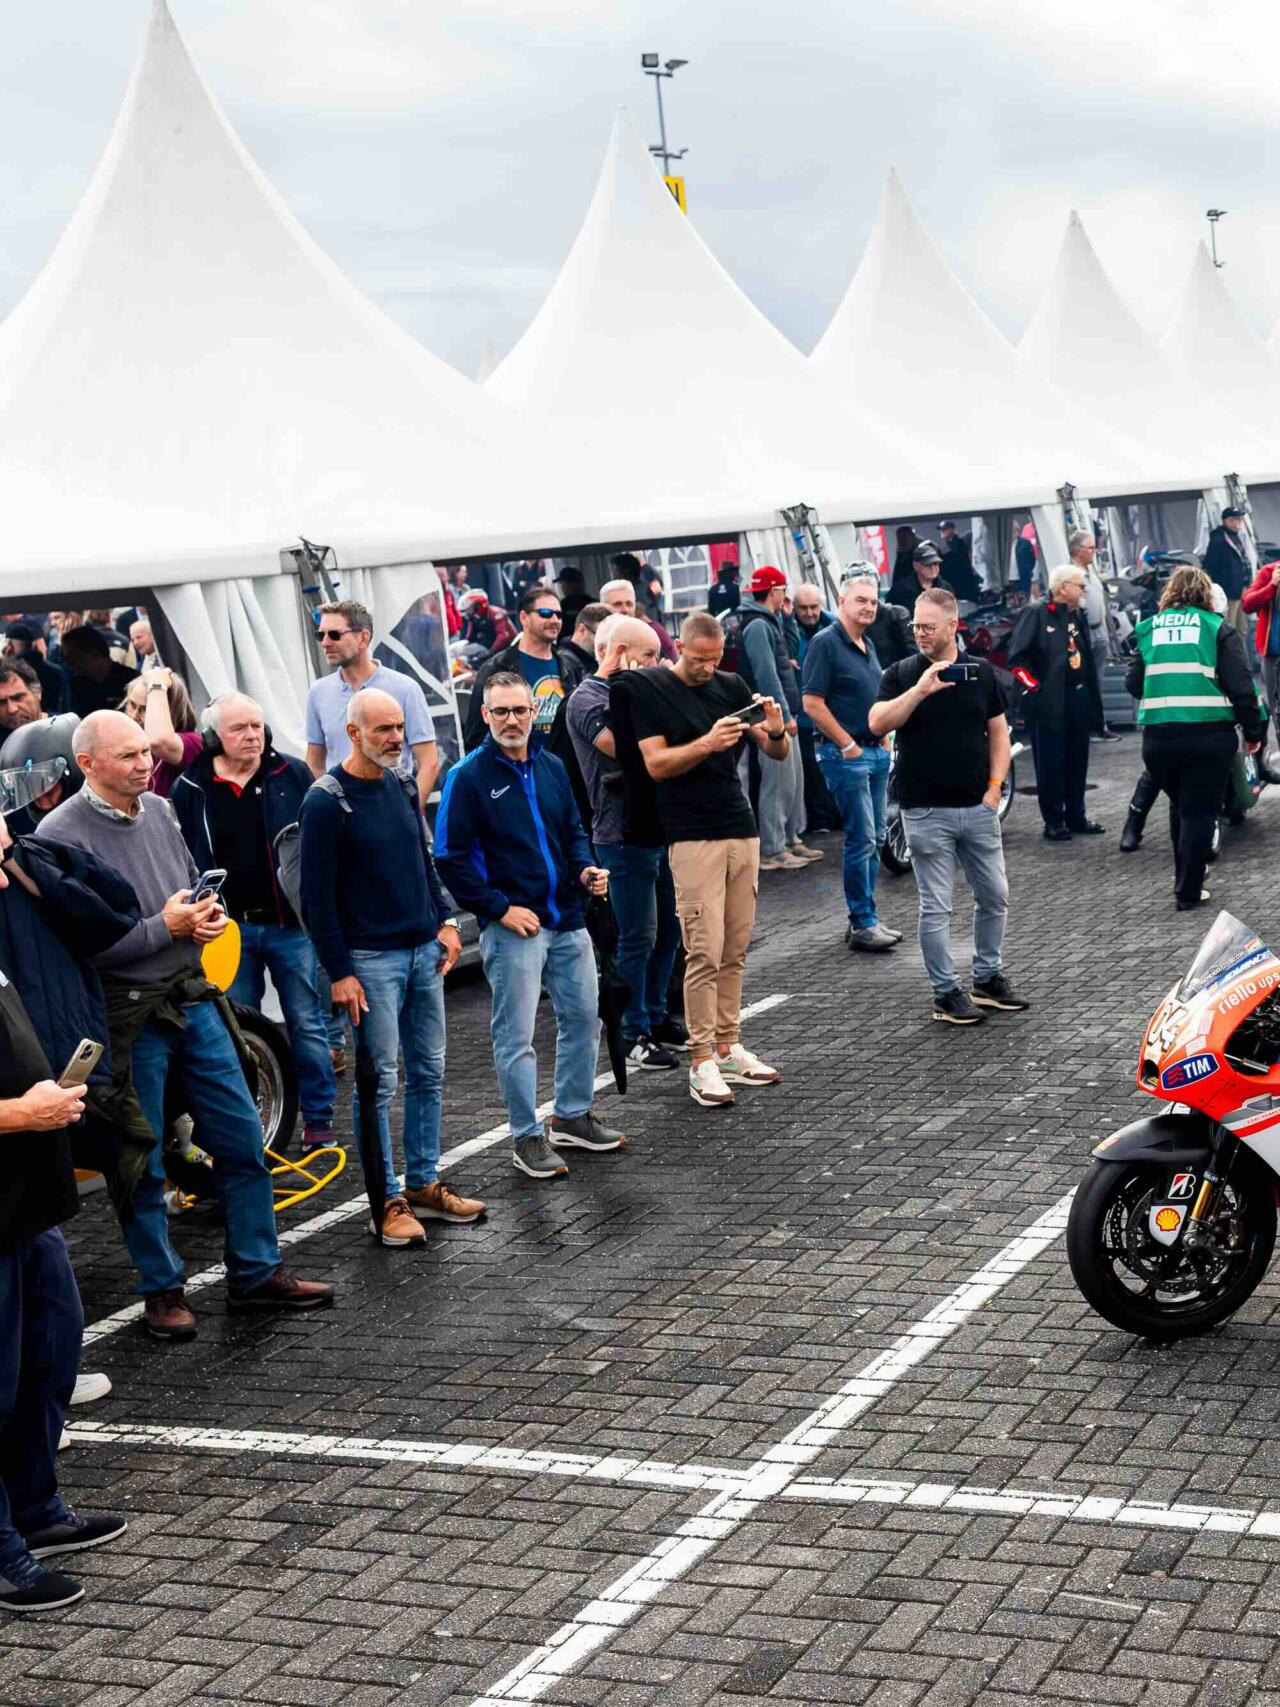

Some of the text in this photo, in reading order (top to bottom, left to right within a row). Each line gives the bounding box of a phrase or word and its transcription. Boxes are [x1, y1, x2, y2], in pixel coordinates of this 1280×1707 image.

[1152, 612, 1201, 628] MEDIA
[1168, 629, 1182, 641] 11
[1218, 971, 1280, 1014] riello ups
[1183, 1057, 1212, 1079] TIM
